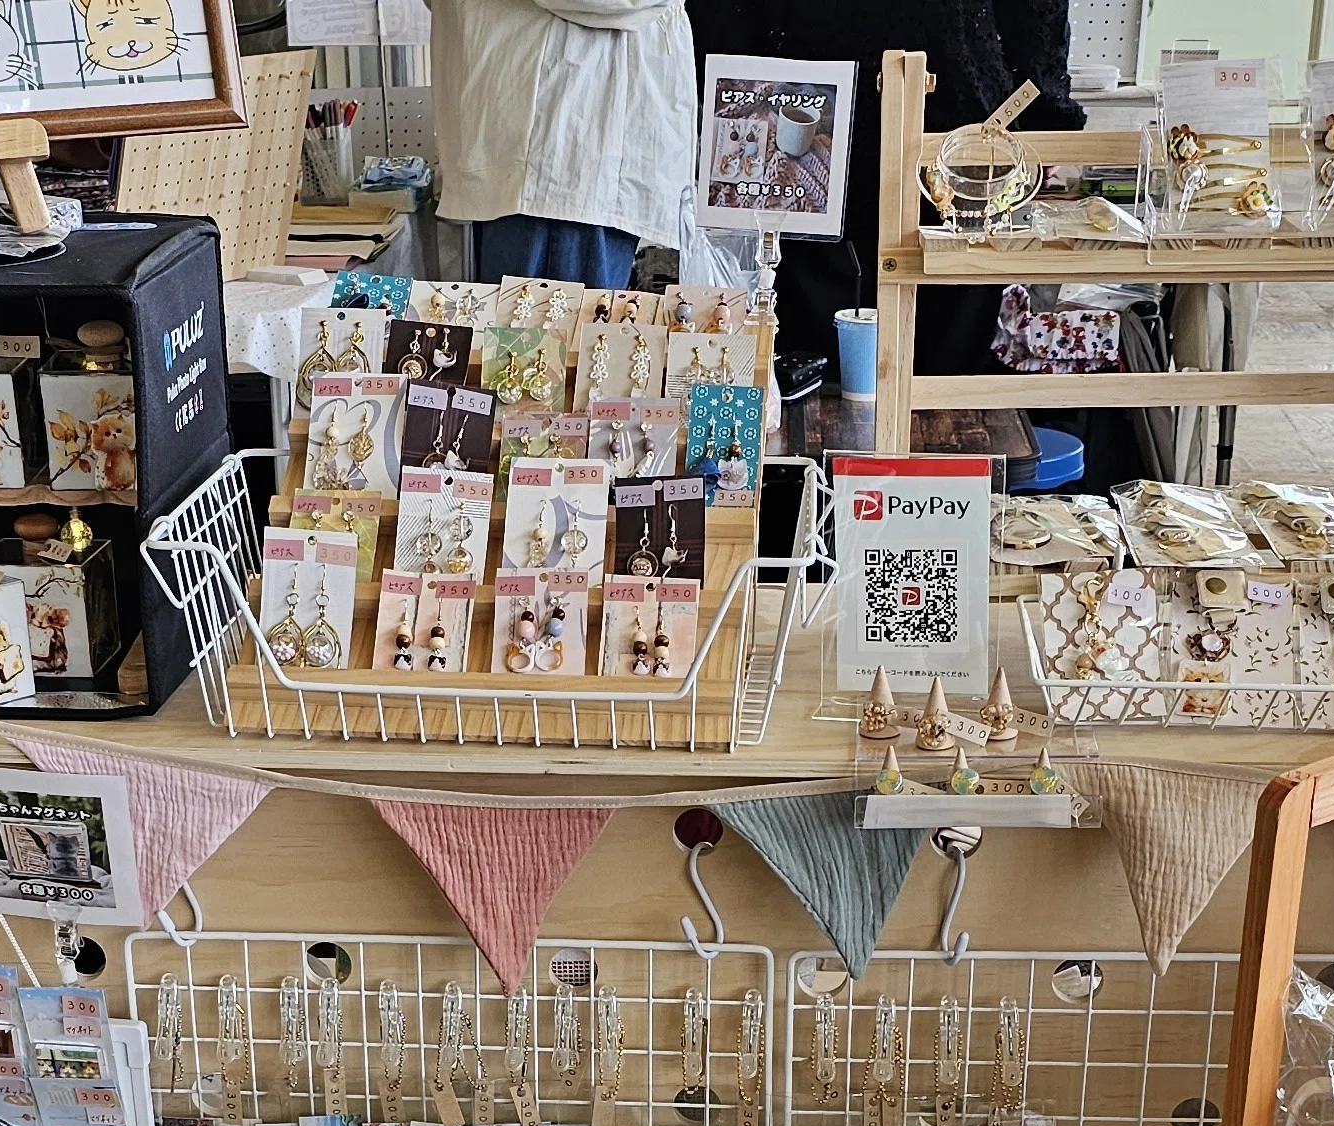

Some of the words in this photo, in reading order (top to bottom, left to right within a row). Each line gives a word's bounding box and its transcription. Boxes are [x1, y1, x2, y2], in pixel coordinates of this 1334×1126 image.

[1219, 72, 1251, 83] 300
[1004, 91, 1030, 118] 500
[366, 380, 394, 389] 350
[458, 394, 486, 410] 350
[644, 408, 674, 418] 350
[552, 421, 582, 431] 350
[567, 470, 598, 479] 350
[458, 484, 488, 496] 350
[669, 485, 698, 495] 350
[887, 495, 971, 519] PayPay
[319, 547, 351, 561] 350
[553, 575, 584, 584] 350
[439, 586, 469, 595] 350
[660, 588, 691, 598] 350
[1252, 587, 1282, 599] 500
[855, 668, 970, 678] こちらのーコードを読み込んでください
[1017, 713, 1049, 730] 300
[956, 722, 987, 739] 300
[991, 782, 1024, 793] 300
[67, 1000, 95, 1013] 300
[80, 1092, 111, 1102] 300
